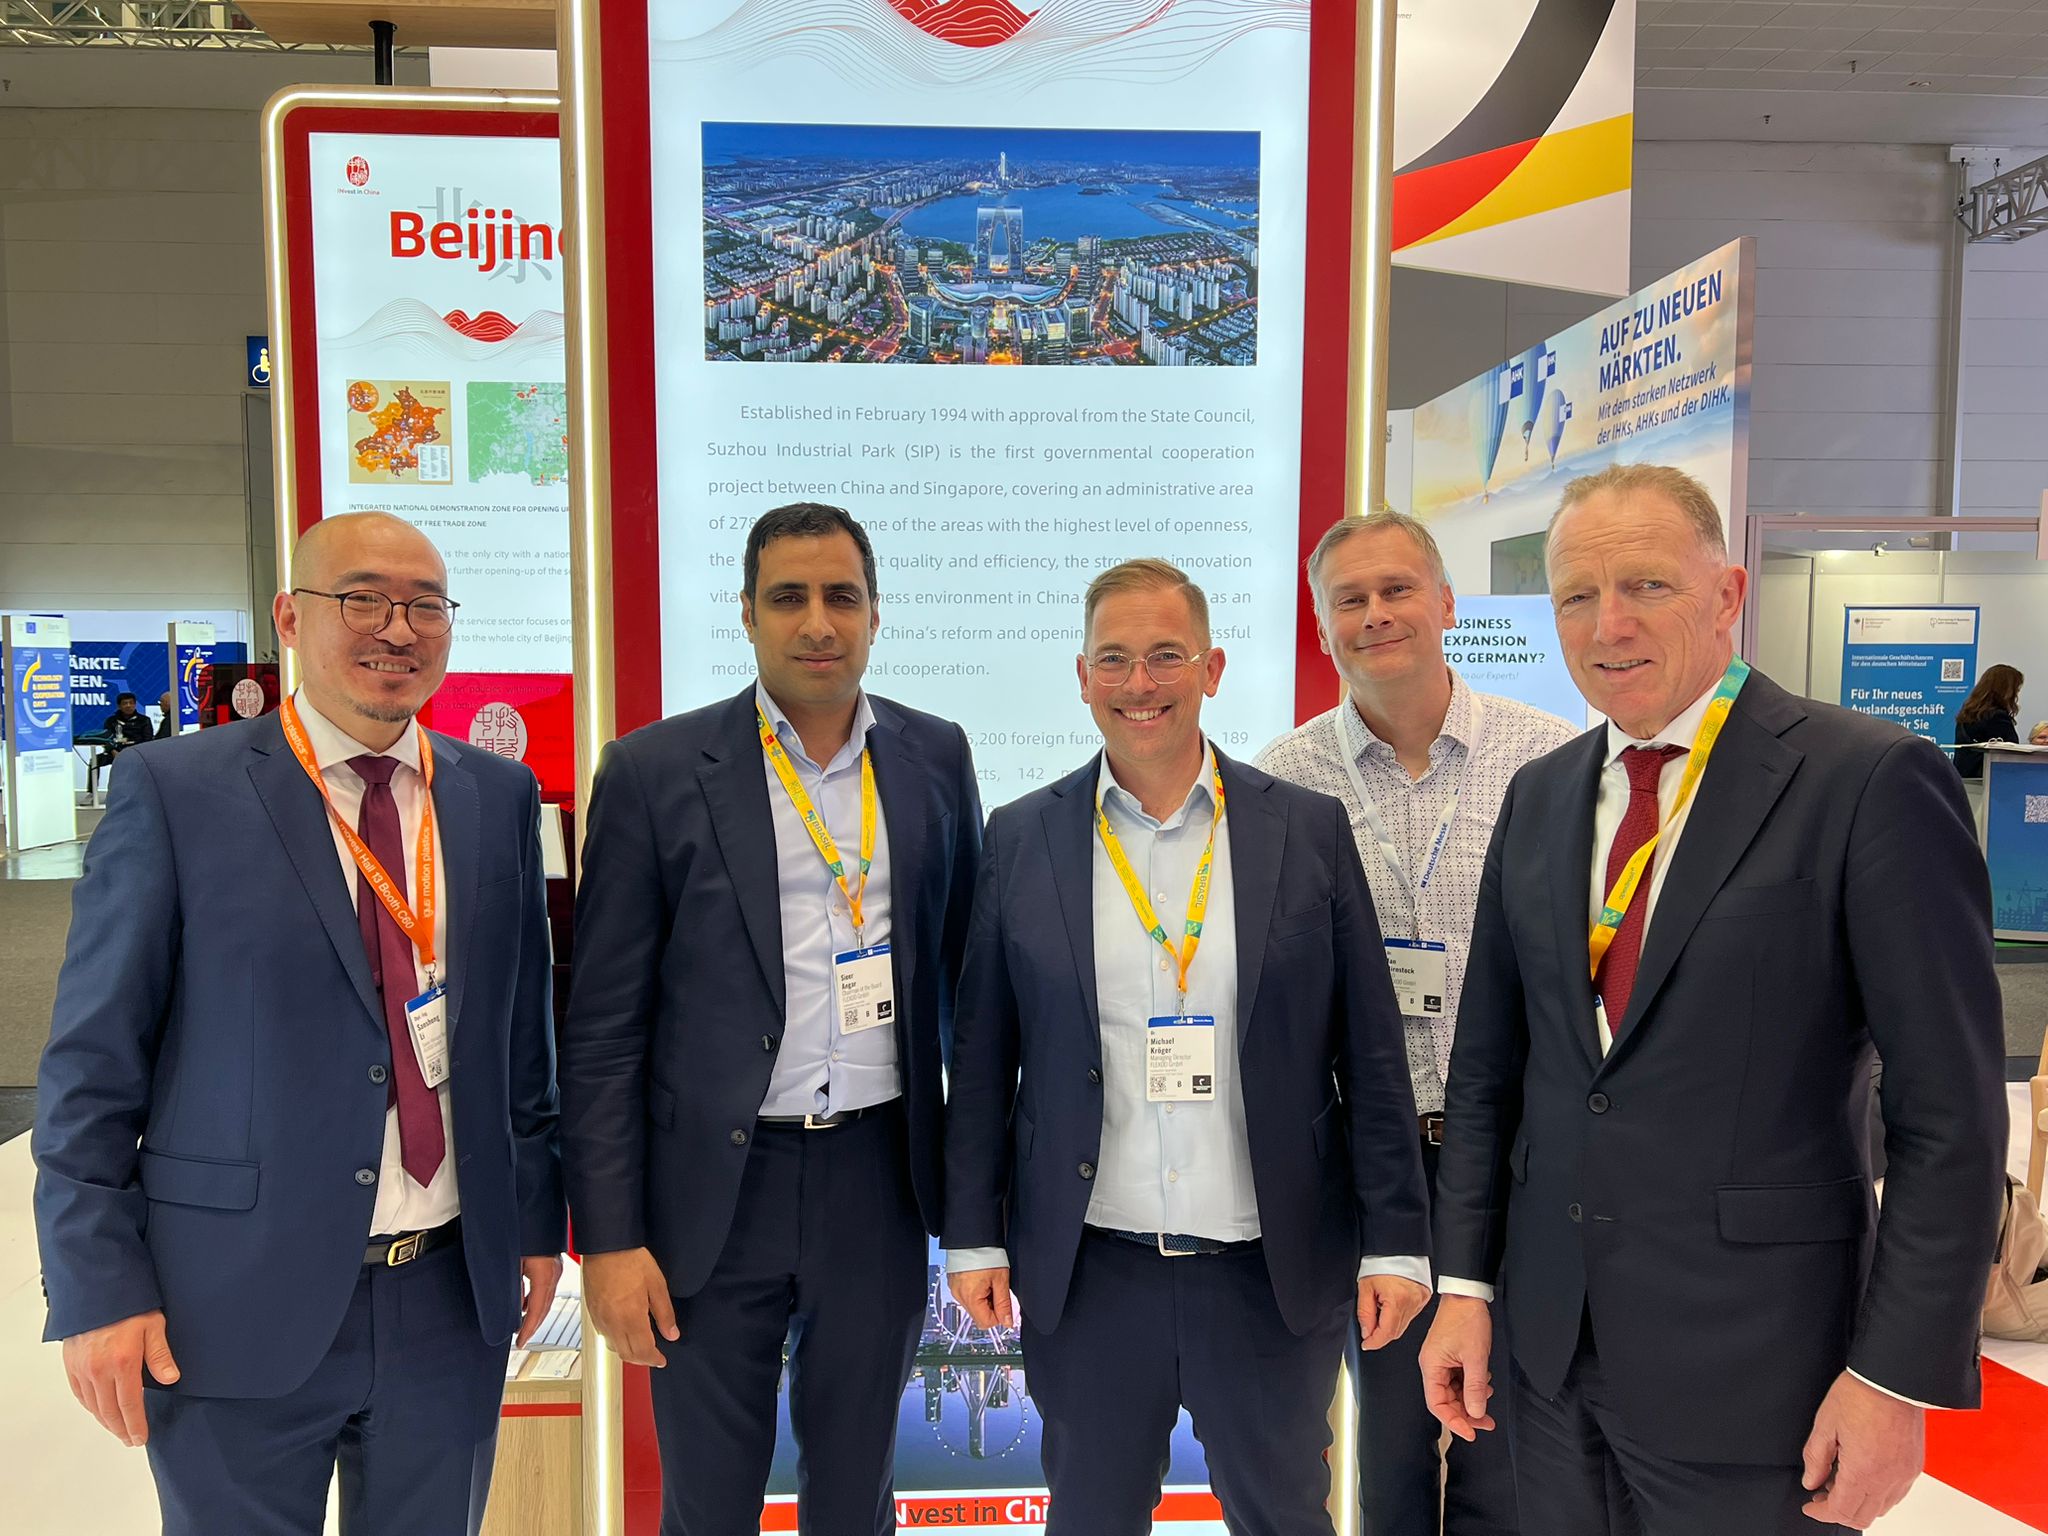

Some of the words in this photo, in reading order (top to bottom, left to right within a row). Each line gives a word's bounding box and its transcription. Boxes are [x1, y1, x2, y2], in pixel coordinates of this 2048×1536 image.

[390, 208, 564, 272] Beijin
[1600, 316, 1629, 356] AUF
[1633, 304, 1654, 340] ZU
[1659, 269, 1722, 328] NEUEN
[1599, 334, 1681, 392] MÄRKTEN.
[1598, 404, 1610, 422] Mit
[1612, 399, 1630, 416] dem
[1632, 385, 1666, 409] starken
[1668, 362, 1717, 394] Netzwerk
[741, 406, 832, 421] Established
[837, 406, 850, 421] in
[856, 407, 925, 424] February
[931, 408, 967, 421] 1994
[971, 408, 1004, 422] with
[1008, 408, 1078, 425] approval
[1082, 408, 1118, 422] from
[1122, 409, 1147, 422] the
[1151, 409, 1190, 422] State
[1194, 409, 1255, 424] Council,
[1597, 425, 1610, 445] der
[1612, 420, 1634, 440] IHKs,
[1635, 411, 1659, 433] AHKs
[1662, 401, 1679, 422] und
[1682, 395, 1698, 417] der
[1700, 385, 1730, 411] DIHK.
[707, 442, 767, 456] Suzhou
[777, 443, 852, 457] Industrial
[861, 444, 895, 458] Park
[905, 445, 940, 461] (SIP)
[949, 445, 961, 458] is
[971, 446, 995, 459] the
[1005, 446, 1035, 459] first
[1044, 446, 1152, 462] governmental
[1162, 446, 1255, 462] cooperation
[708, 480, 764, 496] project
[768, 480, 836, 494] between
[840, 481, 885, 495] China
[889, 481, 919, 495] and
[923, 482, 1008, 498] Singapore,
[1012, 483, 1078, 499] covering
[1082, 484, 1102, 496] an
[1106, 482, 1216, 496] administrative
[1219, 483, 1254, 496] area
[708, 516, 727, 530] of
[892, 517, 908, 531] of
[912, 517, 937, 531] the
[940, 519, 984, 532] areas
[987, 518, 1021, 532] with
[1025, 518, 1049, 532] the
[1054, 518, 1111, 536] highest
[1115, 518, 1151, 532] level
[1155, 518, 1171, 532] of
[1174, 520, 1252, 536] openness,
[445, 550, 451, 558] is
[455, 550, 469, 558] the
[472, 550, 491, 559] only
[494, 551, 509, 560] city
[513, 550, 531, 558] with
[709, 553, 735, 566] the
[889, 555, 943, 571] quality
[948, 554, 978, 568] and
[983, 555, 1059, 572] efficiency,
[1064, 555, 1089, 568] the
[1171, 554, 1252, 568] innovation
[453, 567, 482, 575] further
[485, 568, 535, 576] opening-up
[537, 567, 546, 575] of
[915, 592, 1014, 604] environment
[1017, 592, 1031, 604] in
[1036, 592, 1084, 604] China.
[1210, 593, 1227, 604] as
[1232, 592, 1251, 604] an
[467, 618, 496, 626] service
[498, 618, 524, 626] sector
[526, 617, 558, 626] focuses
[1454, 619, 1512, 629] USINESS
[472, 634, 486, 642] the
[489, 634, 514, 642] whole
[516, 635, 531, 644] city
[533, 634, 543, 642] of
[941, 626, 992, 640] reform
[997, 627, 1026, 640] and
[1031, 627, 1084, 642] openin
[1209, 626, 1251, 639] essful
[1444, 636, 1527, 646] EXPANSION
[69, 655, 126, 670] ÄRKTE.
[1444, 653, 1463, 663] TO
[1467, 653, 1545, 663] GERMANY?
[894, 663, 989, 679] cooperation.
[1487, 672, 1519, 680] Experts!
[70, 675, 108, 687] EEN.
[1851, 689, 1870, 699] Für
[1872, 689, 1889, 699] Ihr
[1891, 690, 1922, 699] neues
[1851, 704, 1945, 717] Auslandsgeschäft
[1914, 719, 1929, 729] Sie
[1012, 732, 1064, 747] foreign
[1222, 732, 1248, 744] 189
[1018, 768, 1044, 780] 142
[420, 826, 432, 861] plastics
[813, 820, 832, 851] BRASIL
[1424, 847, 1440, 880] Deutsche
[1435, 823, 1448, 846] Messe
[360, 853, 376, 873] Hall
[372, 871, 383, 883] 13
[378, 882, 401, 911] Booth
[422, 863, 431, 896] motion
[1196, 876, 1207, 908] BRASIL
[975, 1500, 997, 1522] in
[1005, 1497, 1048, 1522] Chi
